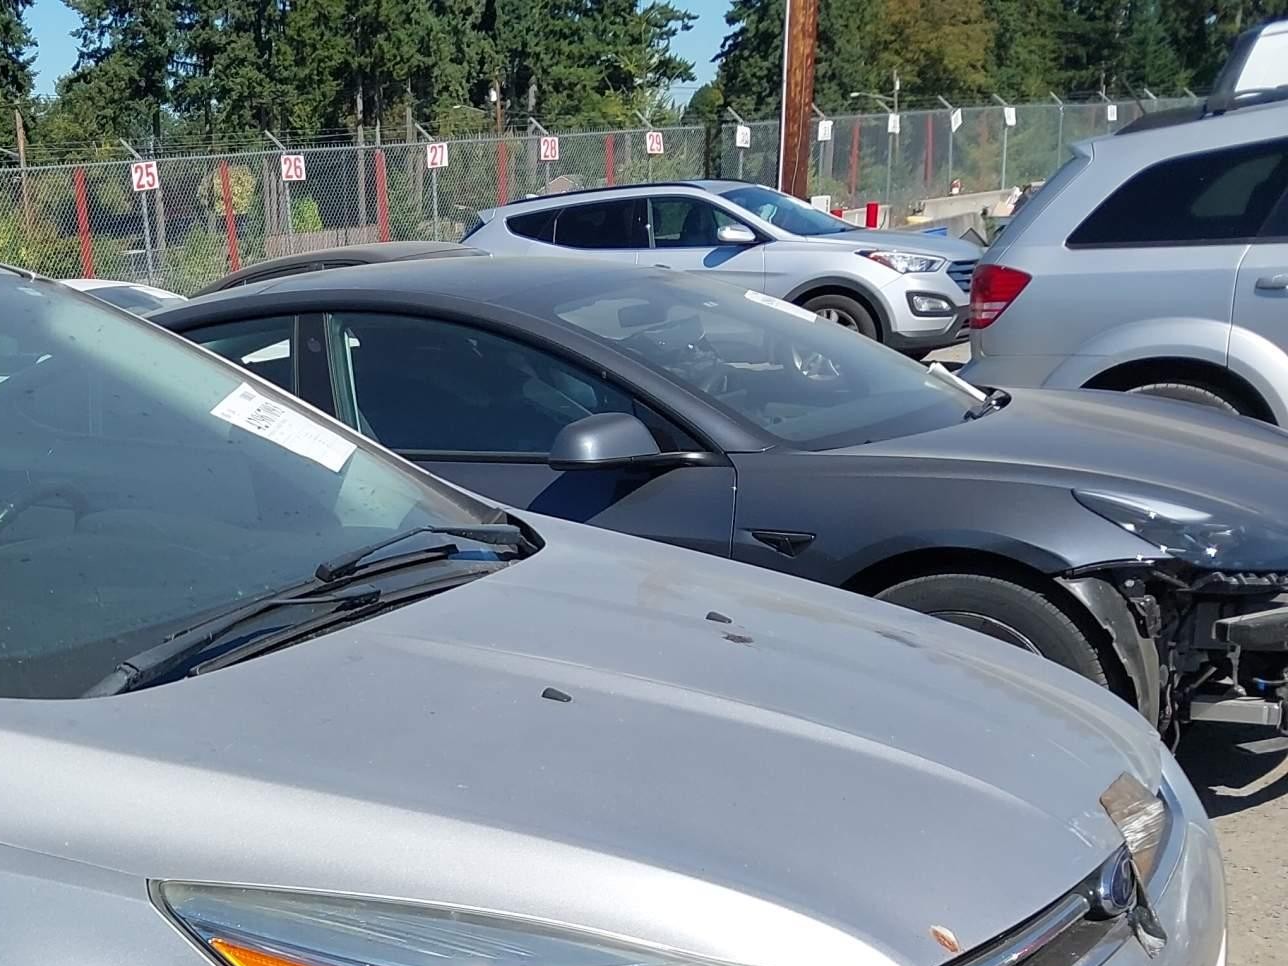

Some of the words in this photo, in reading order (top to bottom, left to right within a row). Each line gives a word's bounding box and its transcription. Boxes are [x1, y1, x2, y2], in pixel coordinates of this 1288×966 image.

[542, 139, 557, 158] 28
[649, 134, 662, 152] 29
[430, 145, 444, 165] 27
[134, 164, 156, 189] 25
[283, 157, 303, 179] 26
